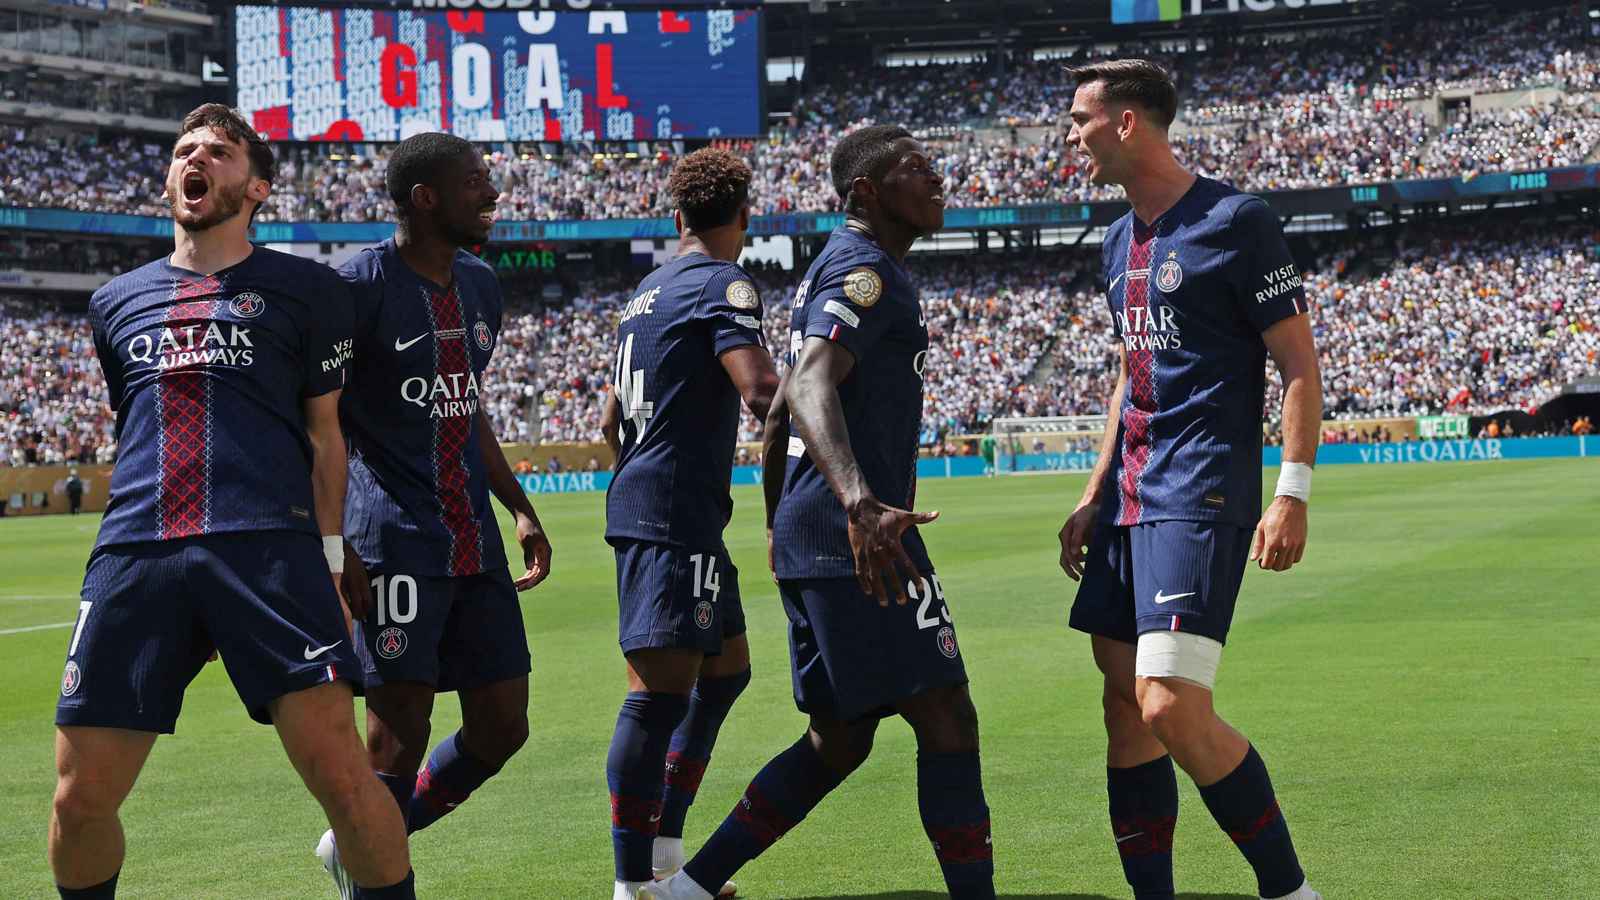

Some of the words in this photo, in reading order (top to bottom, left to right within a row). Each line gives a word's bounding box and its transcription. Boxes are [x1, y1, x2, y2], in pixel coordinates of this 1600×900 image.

[380, 43, 629, 109] GOAL
[482, 249, 557, 270] ATAR
[1263, 263, 1295, 285] VISIT
[1255, 275, 1303, 304] RWAND
[127, 321, 255, 364] QATAR
[156, 347, 254, 370] AIRWAYS
[401, 371, 479, 408] QATA
[429, 399, 478, 419] AIRW
[524, 471, 596, 495] QATAR
[690, 553, 721, 602] 14
[371, 574, 418, 626] 10
[908, 574, 952, 630] 25
[70, 601, 93, 657] 7
